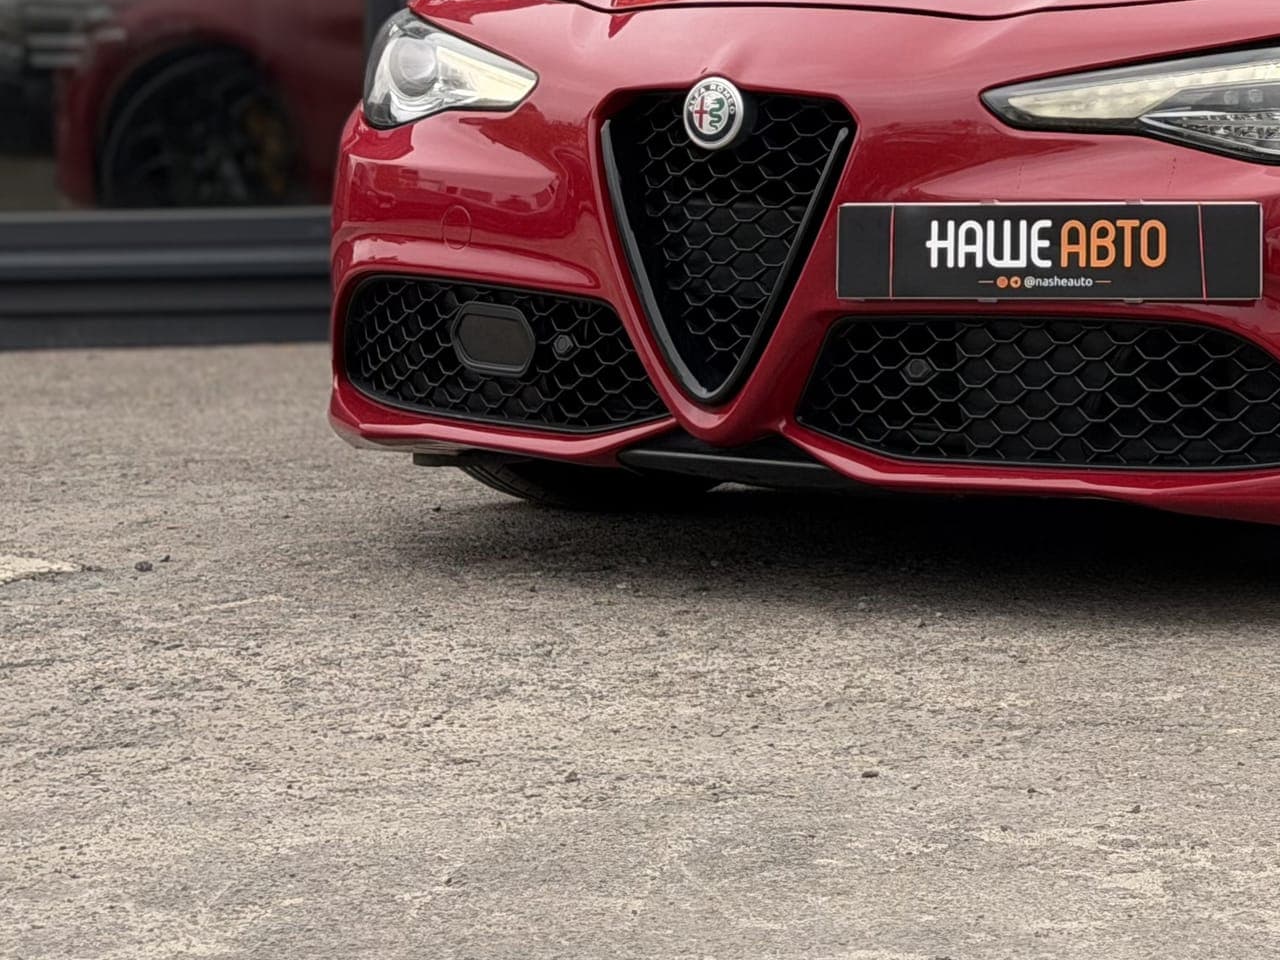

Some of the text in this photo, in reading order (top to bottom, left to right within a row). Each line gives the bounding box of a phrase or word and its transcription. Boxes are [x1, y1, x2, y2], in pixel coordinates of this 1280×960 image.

[709, 83, 736, 116] ROMEO
[925, 219, 1168, 269] НАШЕ АВТО
[1023, 275, 1094, 289] @nasheauto
